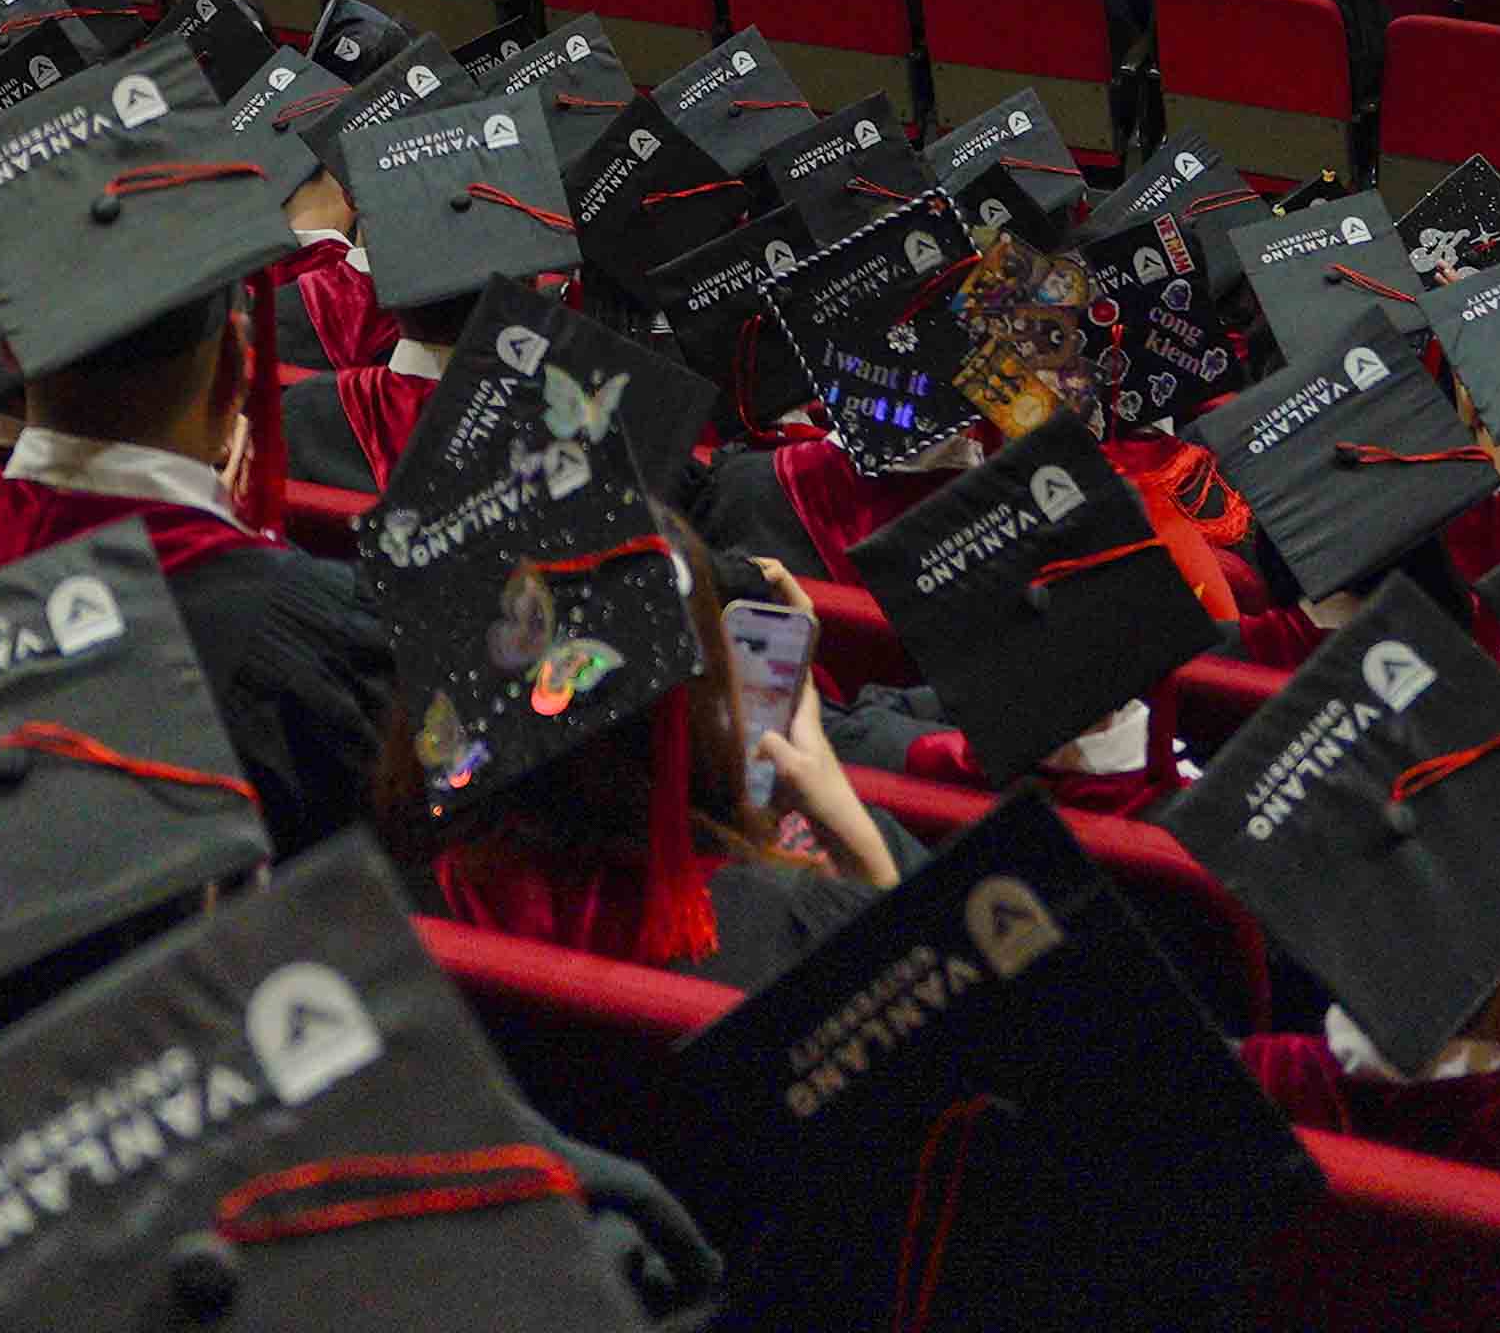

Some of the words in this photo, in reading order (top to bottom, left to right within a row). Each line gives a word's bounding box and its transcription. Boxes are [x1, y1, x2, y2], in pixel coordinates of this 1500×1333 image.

[505, 54, 565, 96] VANLANG
[679, 69, 736, 111] VANLANG
[379, 133, 482, 170] VANLANG
[386, 127, 465, 154] UNIVERSITY
[790, 138, 856, 179] VANLANG
[952, 129, 1011, 169] VANLANG
[580, 156, 637, 223] VANLANG
[1262, 233, 1341, 264] VANLANG
[687, 267, 770, 312] VANLANG
[1247, 383, 1351, 454] VANLANG
[1250, 378, 1326, 435] UNIVERSITY
[409, 482, 536, 567] VANLANG
[916, 512, 1038, 597] VANLANG
[1244, 699, 1340, 808] UNIVERSITY
[1248, 702, 1381, 841] VANLANG
[787, 958, 982, 1118] VANLANG
